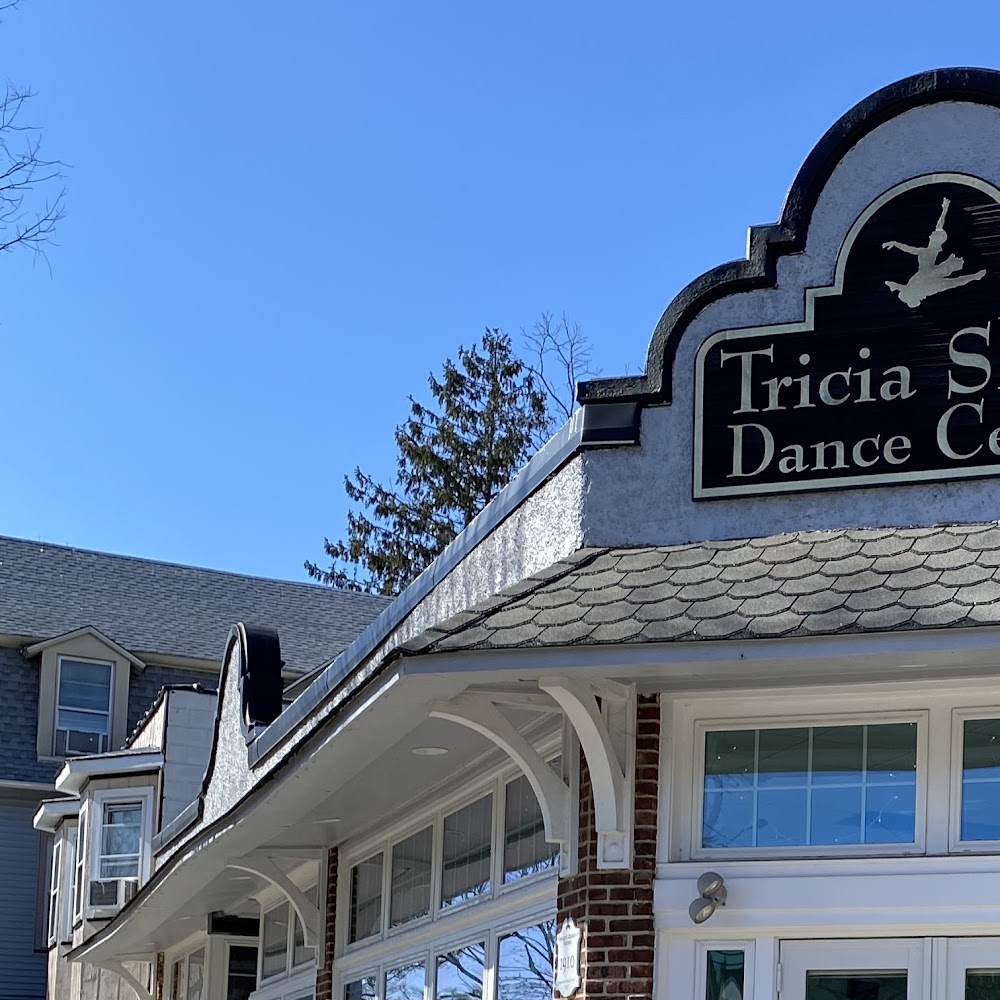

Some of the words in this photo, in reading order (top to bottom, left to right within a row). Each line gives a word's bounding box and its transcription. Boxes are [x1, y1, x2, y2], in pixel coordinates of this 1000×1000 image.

[720, 344, 917, 415] Tricia
[726, 423, 912, 479] Dance
[559, 955, 575, 974] 1910
